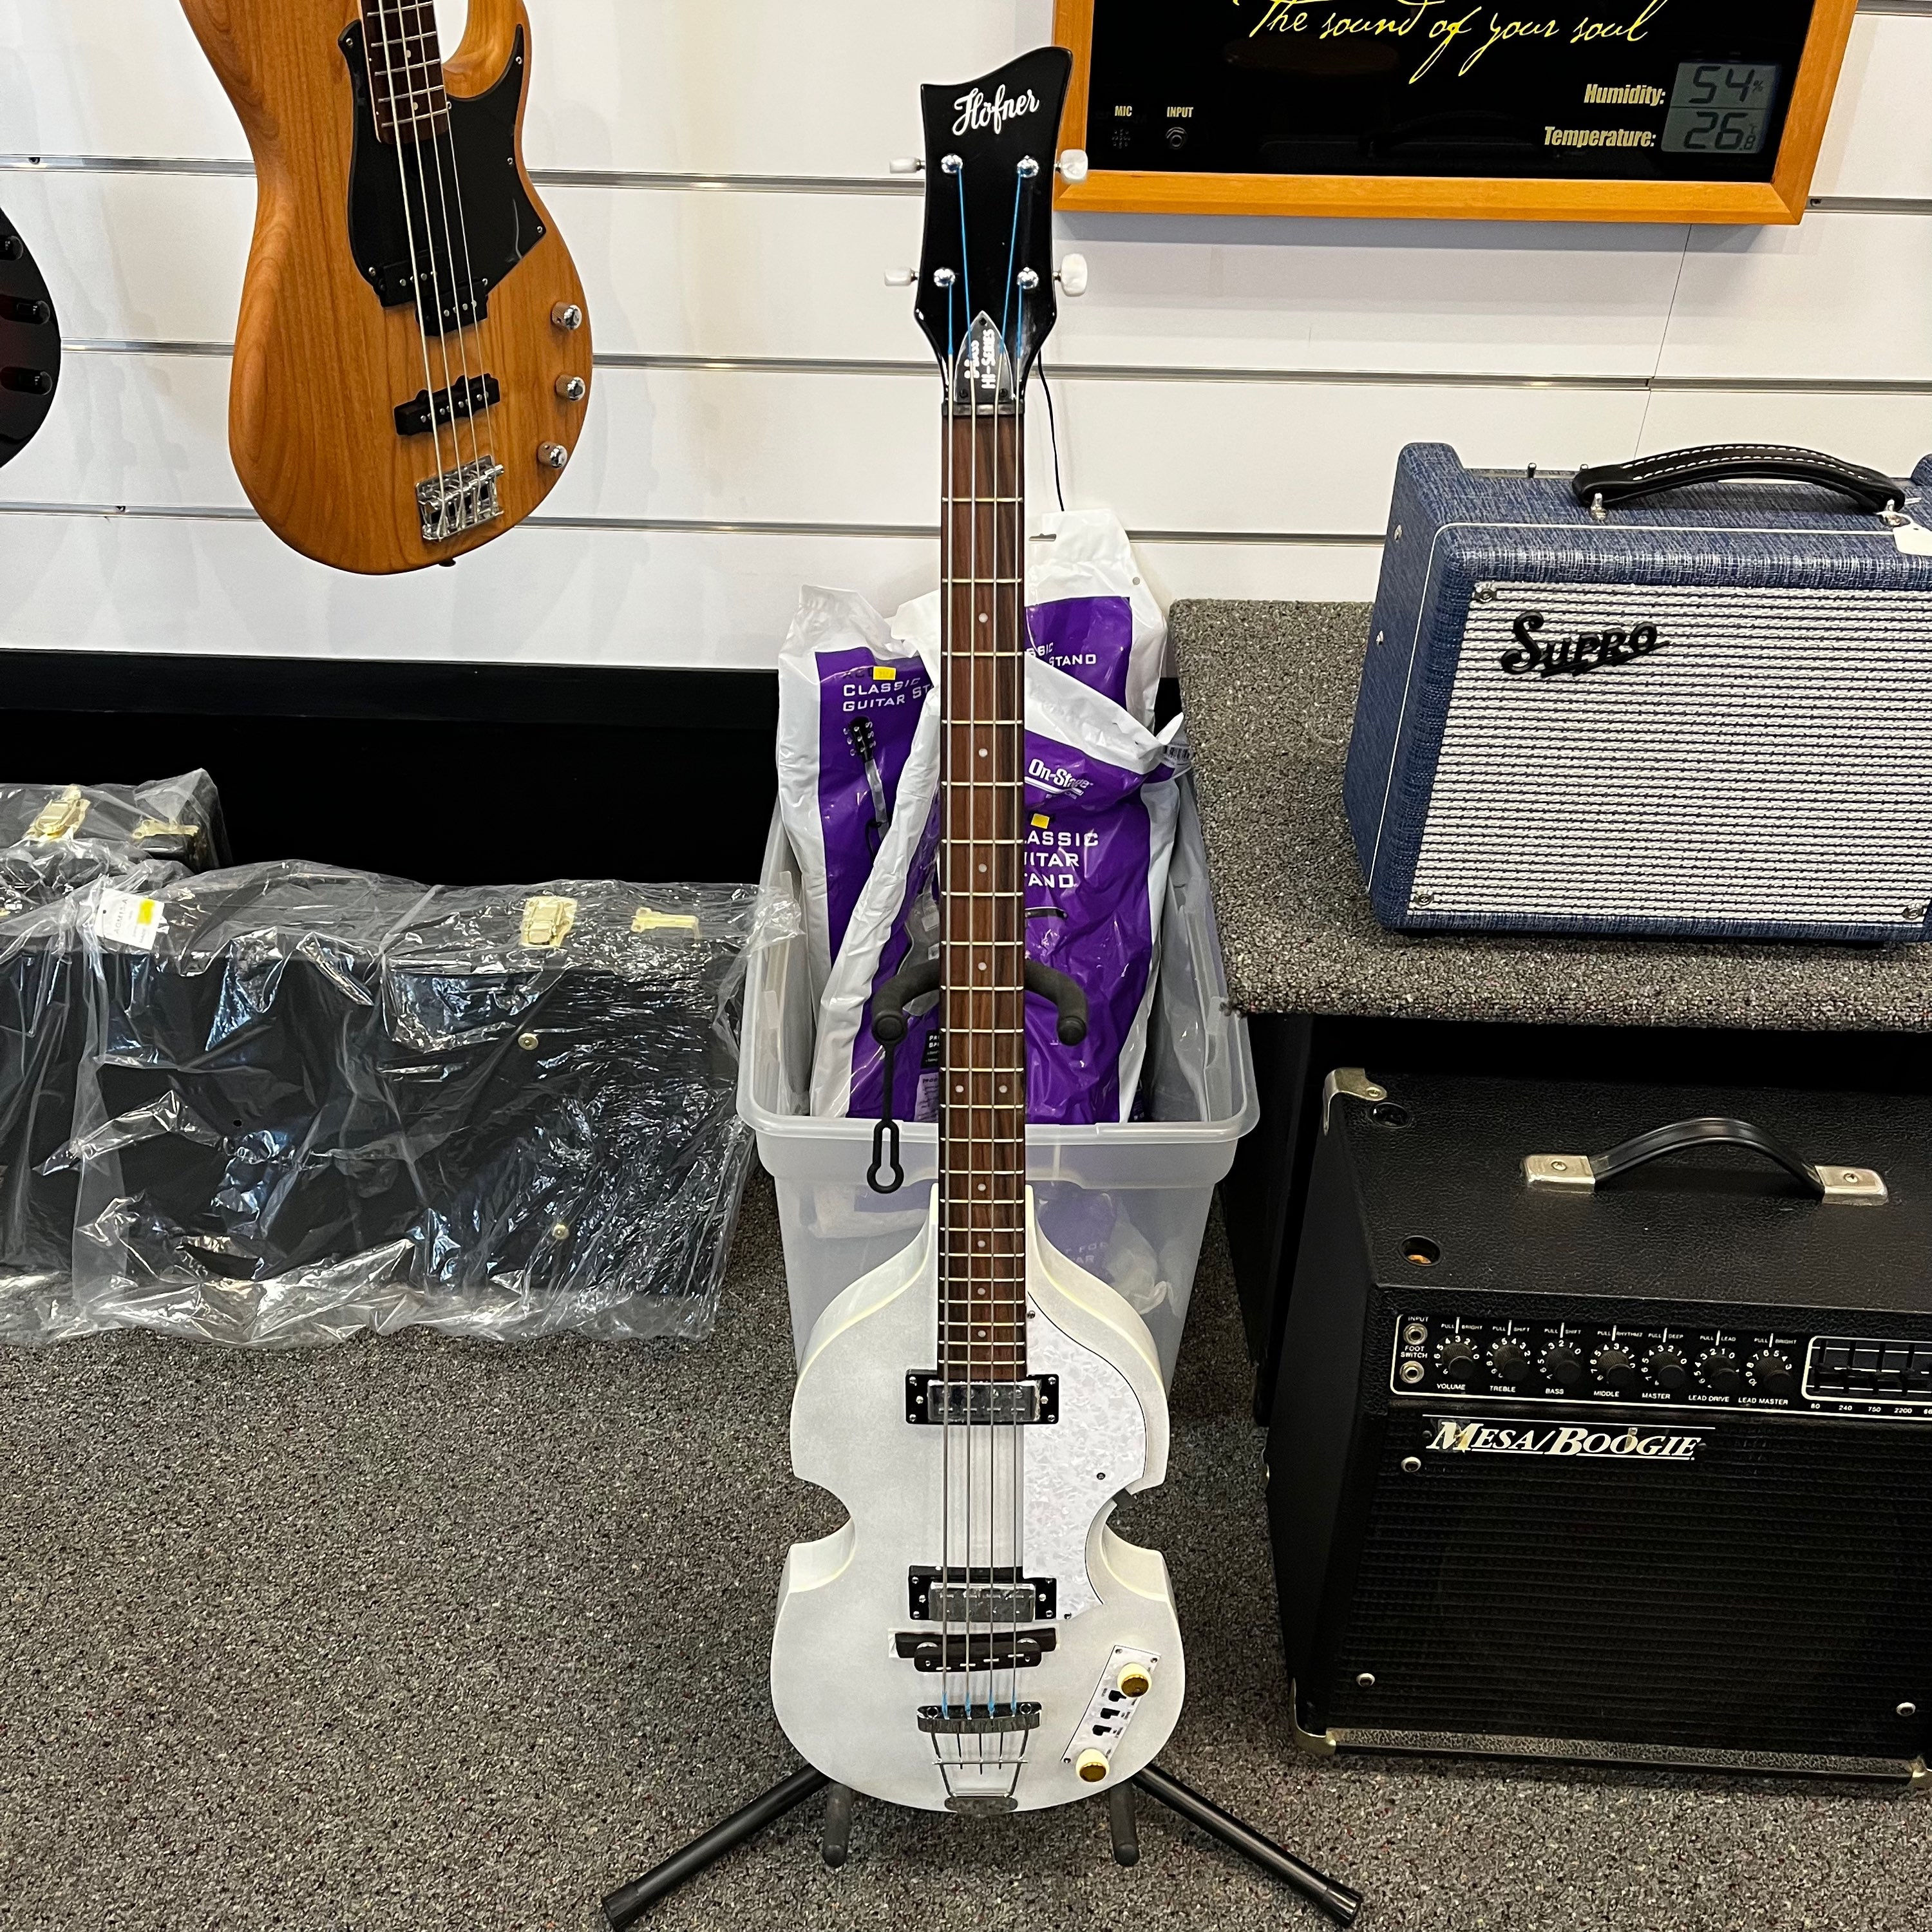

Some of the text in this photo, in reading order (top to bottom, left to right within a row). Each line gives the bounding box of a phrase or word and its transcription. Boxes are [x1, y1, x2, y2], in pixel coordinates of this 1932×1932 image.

[1249, 0, 1668, 84] The sound of your soul
[1583, 83, 1666, 106] Humidity:
[1114, 105, 1133, 117] MIC
[1166, 106, 1194, 118] INPUT
[1544, 126, 1656, 148] Temperature:
[1048, 653, 1096, 667] STAND
[843, 677, 921, 697] CLASSIC
[842, 683, 934, 712] GUITAR ST
[1024, 830, 1099, 847] ASSIC
